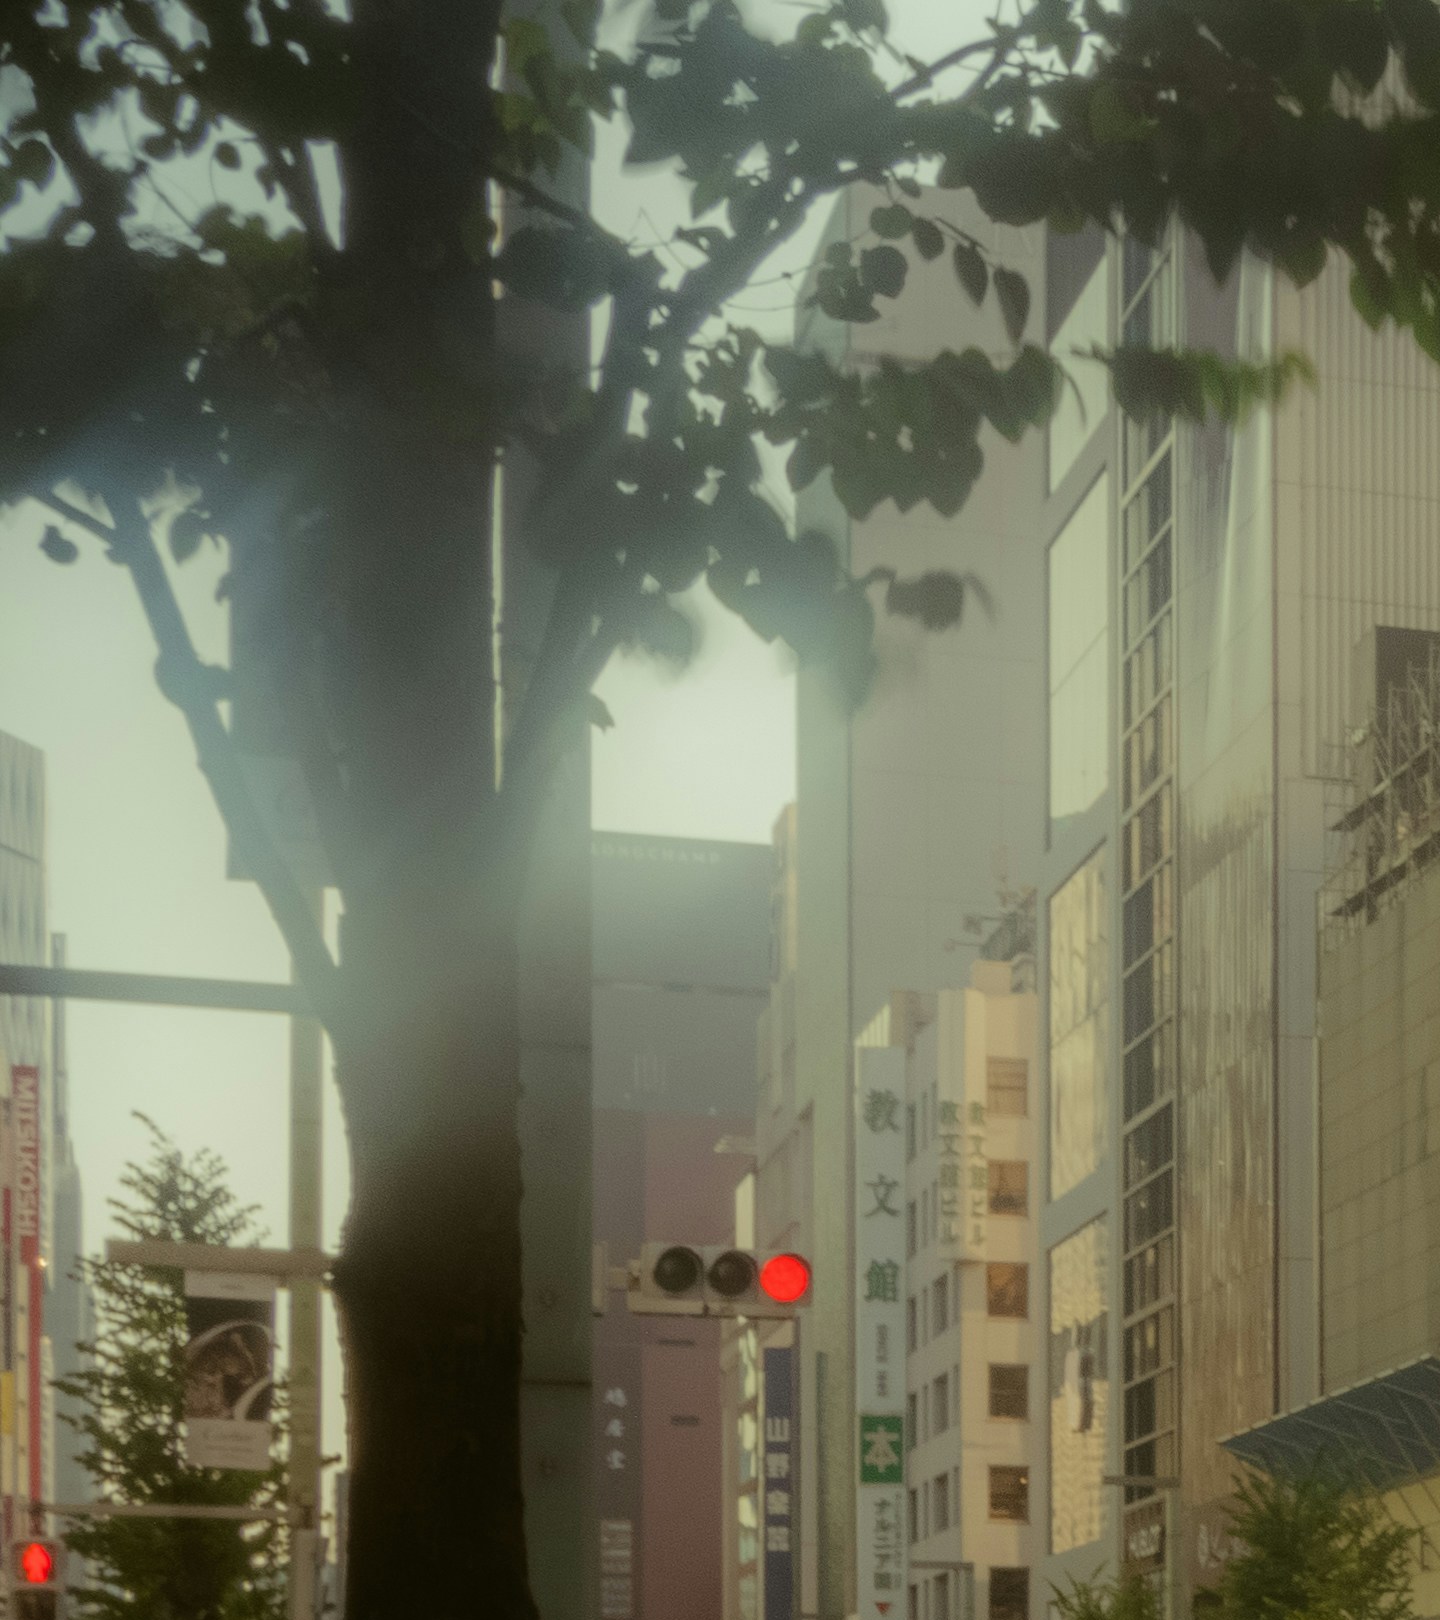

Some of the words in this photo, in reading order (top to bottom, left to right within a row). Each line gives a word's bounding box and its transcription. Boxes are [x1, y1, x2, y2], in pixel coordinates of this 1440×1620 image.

[15, 1073, 37, 1236] MITSUKOSHI
[863, 1088, 900, 1303] 教文館
[864, 1424, 900, 1474] 本
